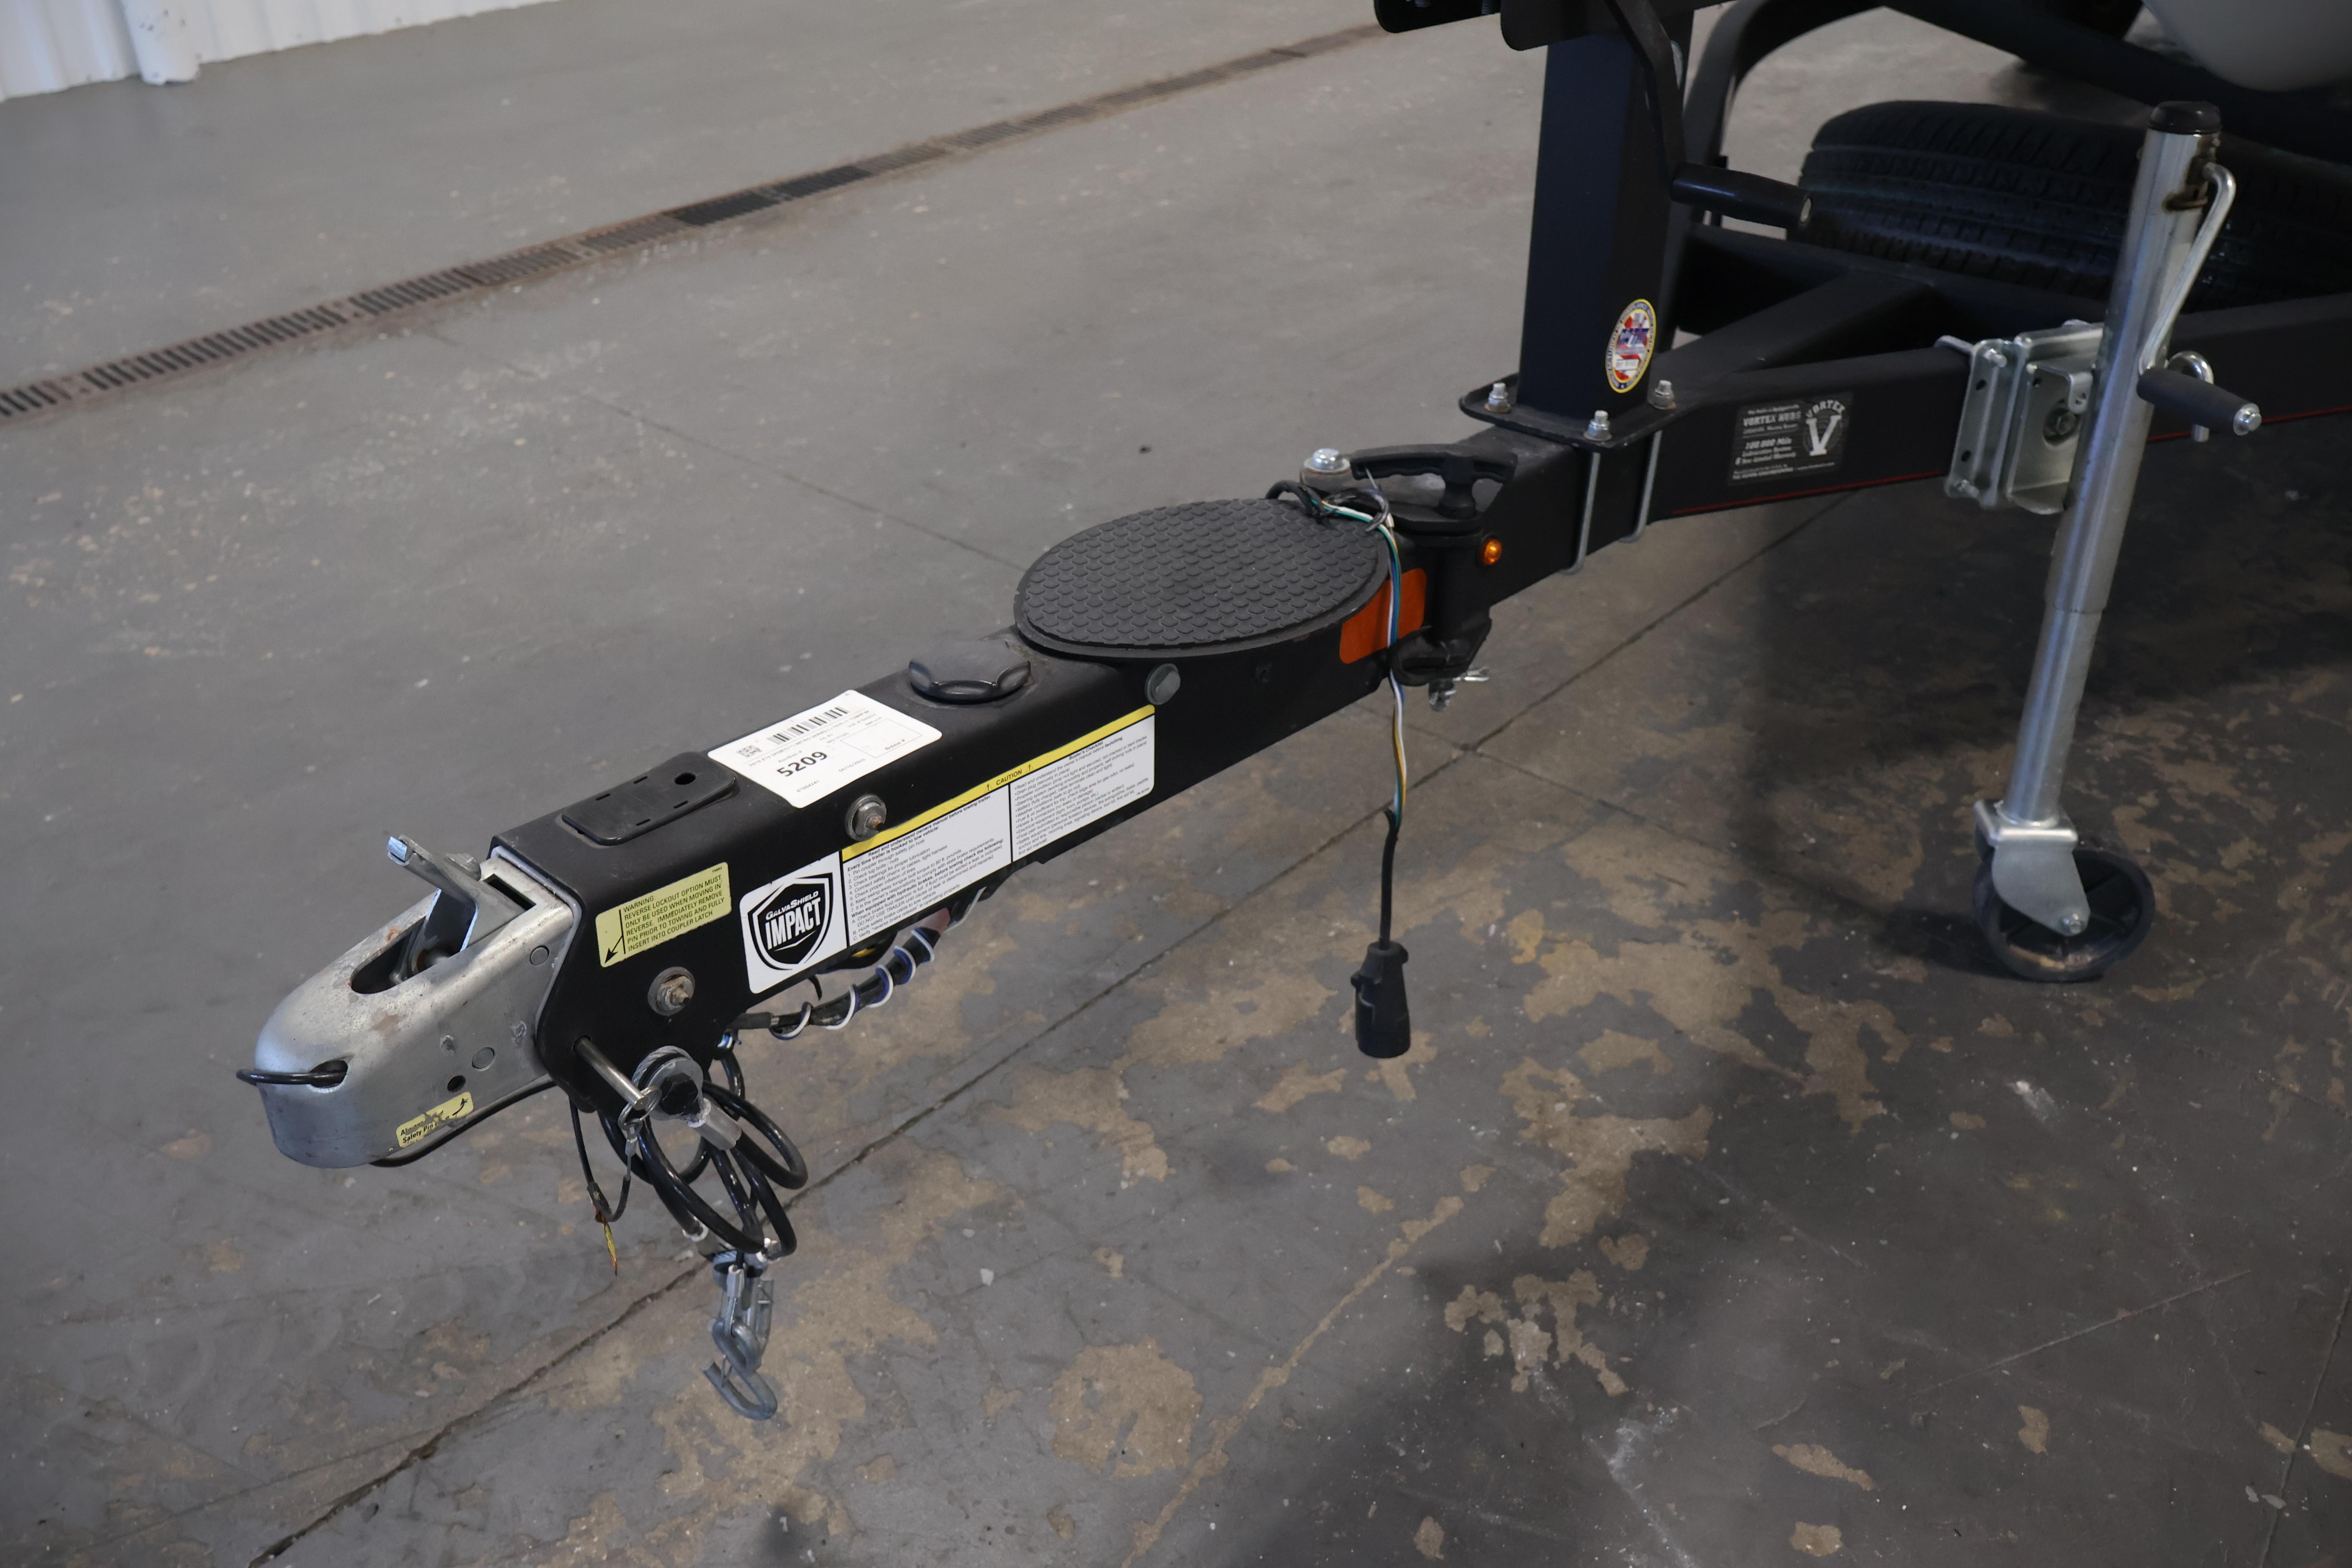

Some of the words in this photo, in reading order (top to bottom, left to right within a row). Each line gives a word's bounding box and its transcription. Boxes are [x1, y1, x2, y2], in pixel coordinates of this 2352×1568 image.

[777, 752, 827, 777] 5209
[996, 769, 1022, 785] CAUTION
[868, 848, 880, 857] Read
[890, 832, 916, 847] understand
[915, 825, 932, 835] owners
[933, 816, 948, 826] manual
[949, 809, 962, 818] before
[963, 802, 978, 811] towing
[848, 863, 860, 872] Every
[872, 852, 885, 860] trailer
[891, 841, 908, 851] hooked
[854, 878, 867, 887] Check
[868, 869, 887, 880] bearings
[894, 859, 908, 869] proper
[909, 848, 930, 861] lubrication
[854, 881, 873, 893] Connect
[873, 875, 886, 884] safety
[886, 869, 900, 877] chains
[931, 845, 947, 855] harness
[861, 862, 877, 871] coupler
[878, 854, 895, 864] through
[895, 848, 907, 856] safety
[851, 909, 864, 918] When
[865, 898, 886, 911] equipped
[897, 884, 917, 896] hydraulic
[935, 867, 948, 877] before
[949, 860, 963, 869] towing
[964, 853, 976, 861] check
[853, 872, 867, 881] Check
[855, 889, 869, 898] Check
[869, 882, 883, 892] proper
[884, 874, 901, 884] inflation
[867, 884, 892, 898] swing-away
[893, 877, 907, 886] tongue
[916, 866, 930, 875] torque
[872, 892, 888, 902] owner's
[889, 878, 916, 894] responsibility
[922, 868, 937, 878] comply
[624, 905, 651, 920] REVERSE
[652, 893, 679, 909] LOCKOUT
[681, 883, 703, 896] OPTION
[705, 875, 721, 886] MUST
[625, 917, 641, 928] ONLY
[642, 913, 650, 921] BE
[652, 906, 668, 917] USED
[669, 897, 688, 909] WHEN
[689, 886, 713, 901] MOVING
[657, 901, 697, 922] IMMEDIATELY
[699, 890, 722, 905] REMOVE
[857, 912, 871, 921] Check
[872, 906, 884, 914] brake
[894, 892, 912, 903] reservoir
[866, 915, 875, 923] NOT
[876, 909, 886, 918] USE
[887, 900, 905, 912] TRAILER
[915, 890, 927, 898] cause
[871, 918, 883, 926] safety
[884, 911, 896, 920] brake
[922, 891, 936, 900] vehicle
[889, 915, 901, 923] brake
[924, 893, 943, 905] operating
[627, 935, 638, 944] PIN
[639, 926, 658, 938] PRIOR
[668, 911, 693, 926] TOWING
[694, 905, 707, 915] AND
[708, 897, 724, 909] FULLY
[628, 938, 650, 951] INSERT
[652, 931, 666, 941] INTO
[667, 918, 693, 934] COUPLER
[695, 910, 713, 922] LATCH
[765, 897, 821, 951] IMPACT
[403, 1130, 422, 1143] Safety
